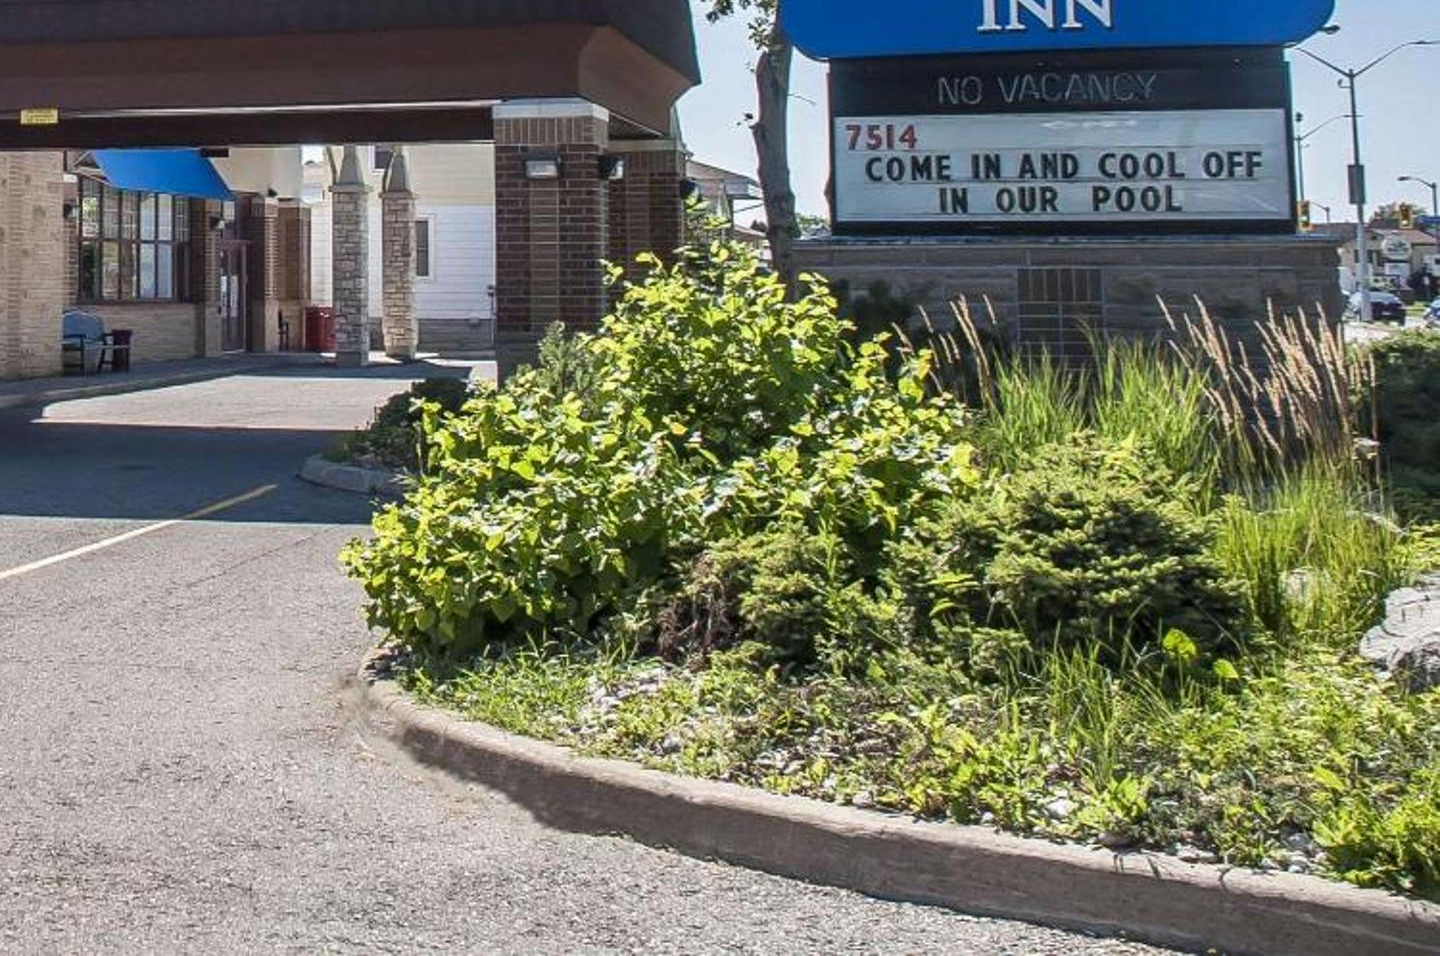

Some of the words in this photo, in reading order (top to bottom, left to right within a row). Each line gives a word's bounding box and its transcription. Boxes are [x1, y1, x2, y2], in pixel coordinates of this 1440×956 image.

[937, 76, 982, 105] NO
[996, 72, 1157, 104] VACANCY
[845, 124, 918, 151] 7514
[865, 154, 951, 182] COME
[971, 153, 1001, 180] IN
[1018, 153, 1079, 180] AND
[1098, 151, 1186, 179] COOL
[1203, 150, 1263, 178] OFF
[939, 187, 968, 214] IN
[996, 185, 1059, 212] OUR
[1092, 184, 1183, 212] POOL
